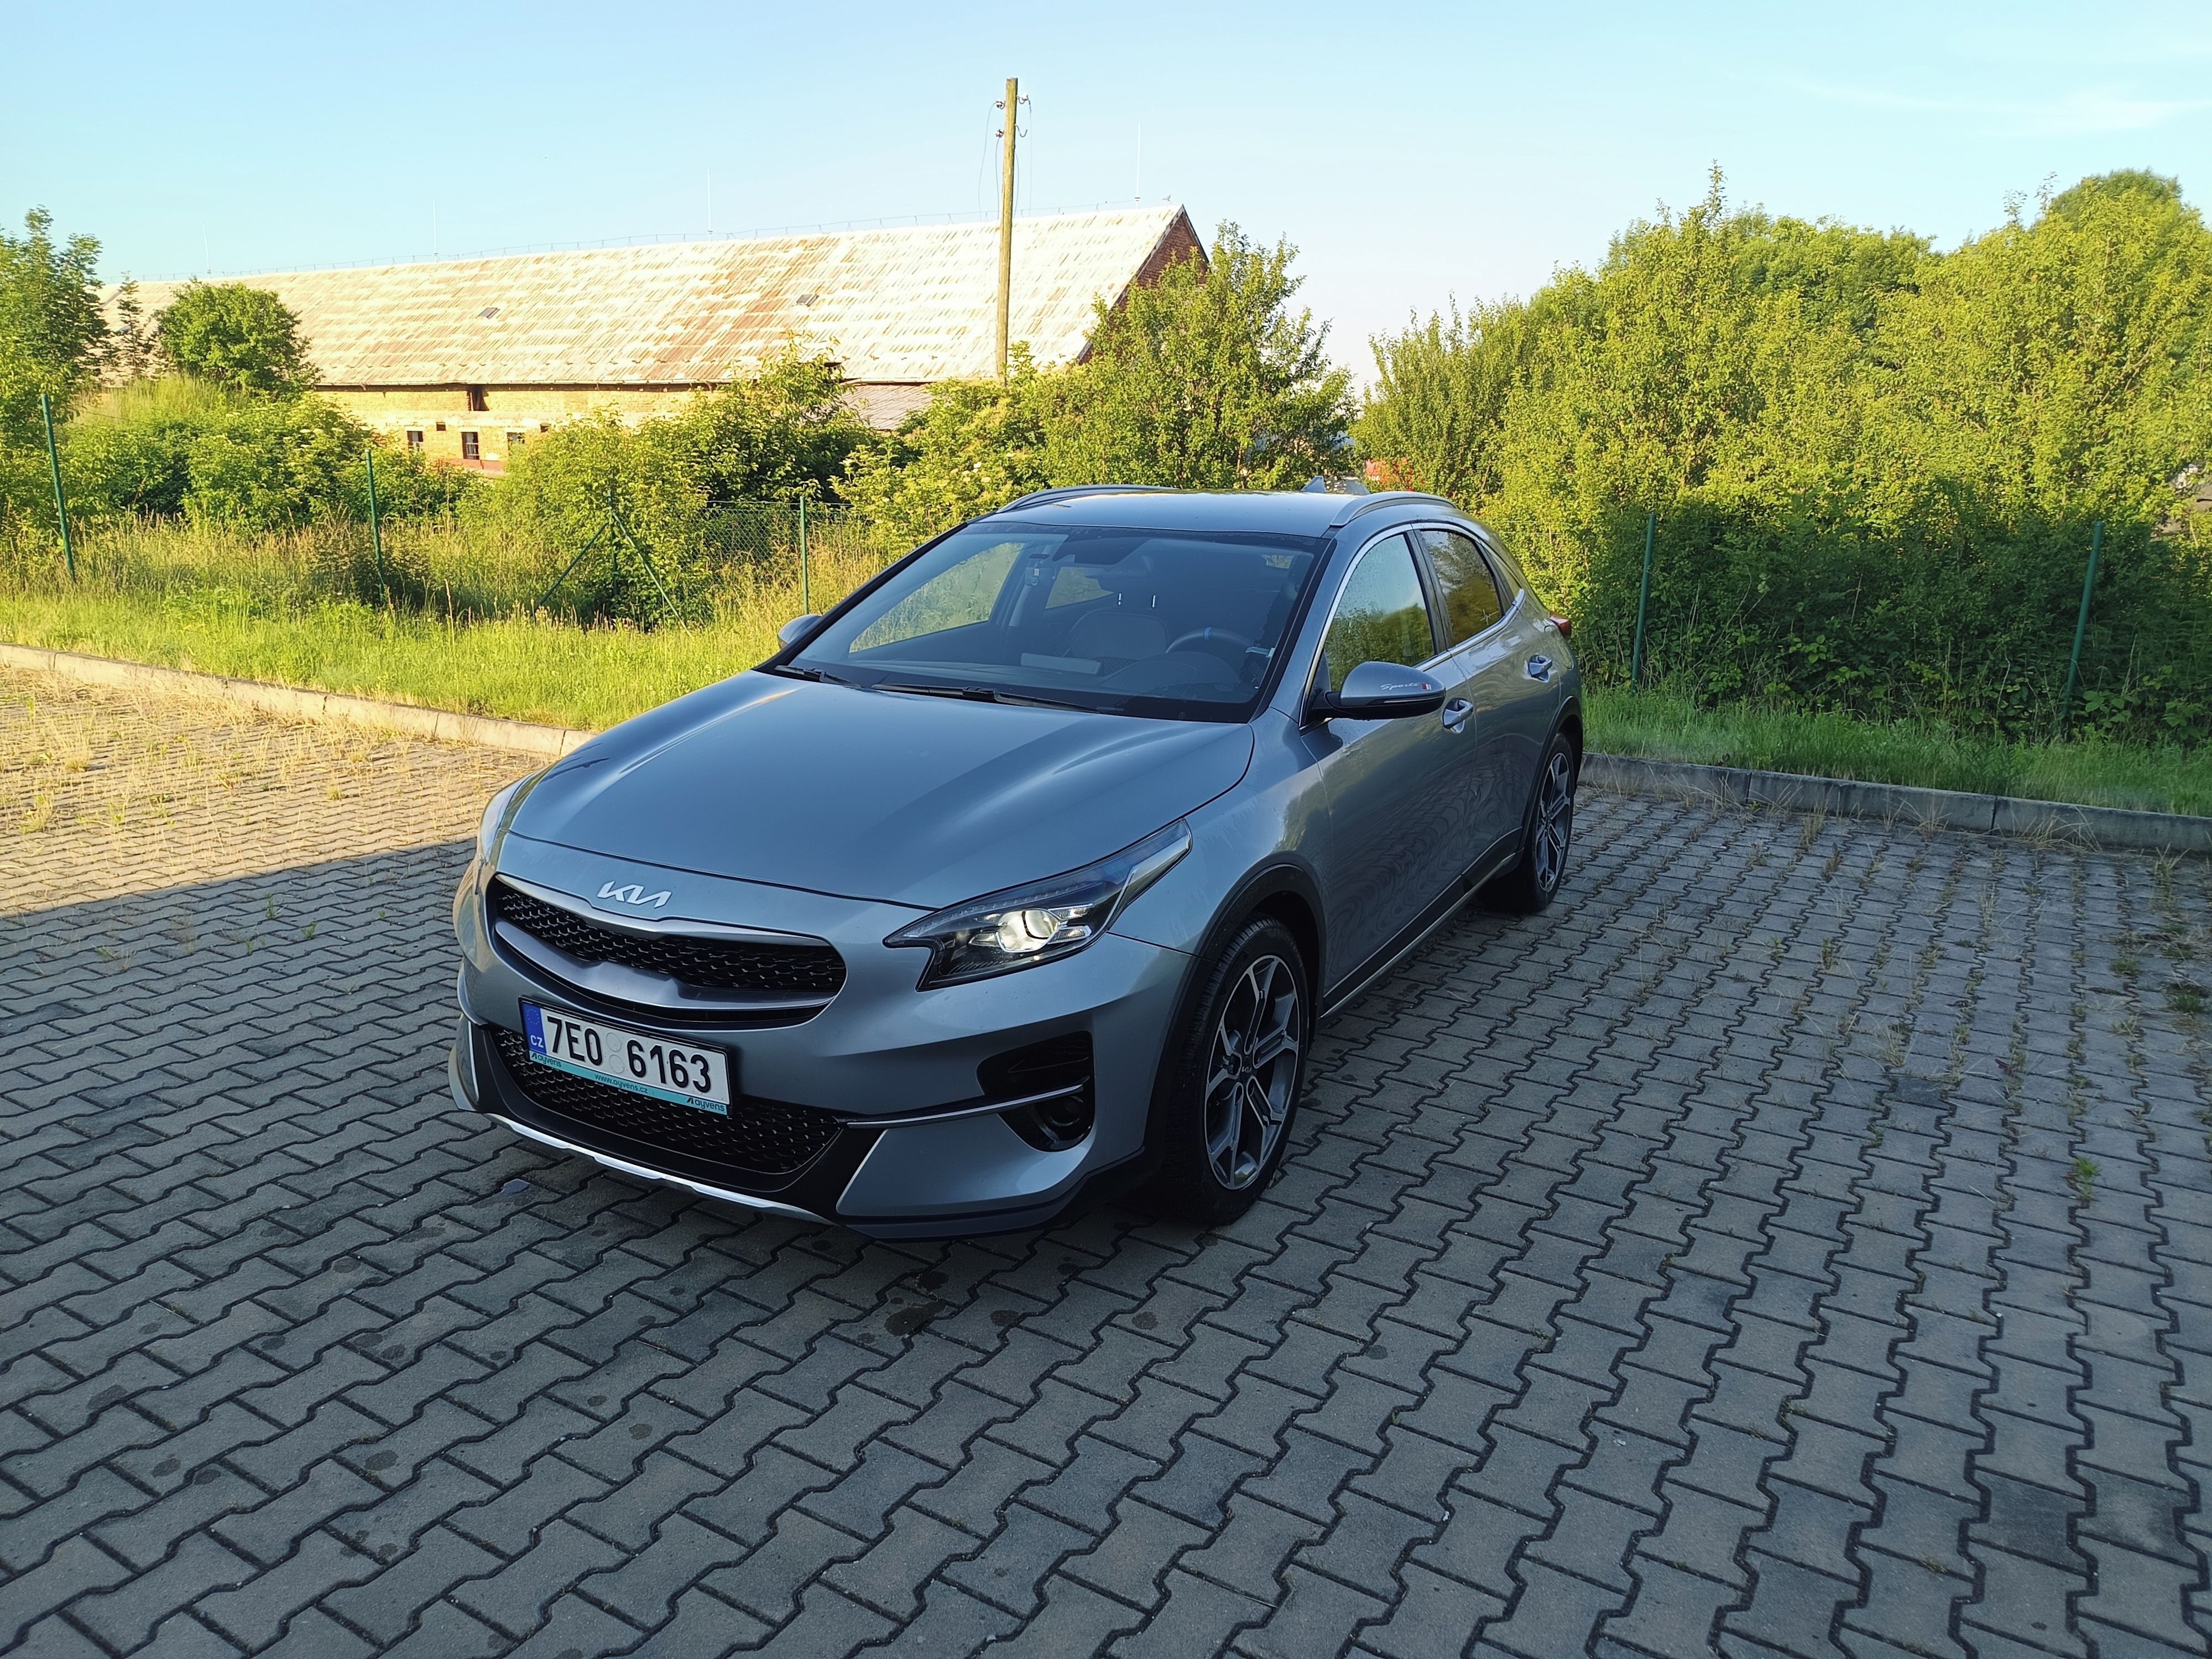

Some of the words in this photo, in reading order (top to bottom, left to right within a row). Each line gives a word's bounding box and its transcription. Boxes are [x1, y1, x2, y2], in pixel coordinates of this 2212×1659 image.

[597, 880, 672, 909] KIA
[530, 1034, 544, 1048] CZ
[538, 1055, 562, 1067] ayvens
[546, 1015, 603, 1066] 7E0
[627, 1040, 712, 1093] 6163
[594, 1074, 648, 1094] www.ayvens.cz
[695, 1099, 724, 1112] ayvens
